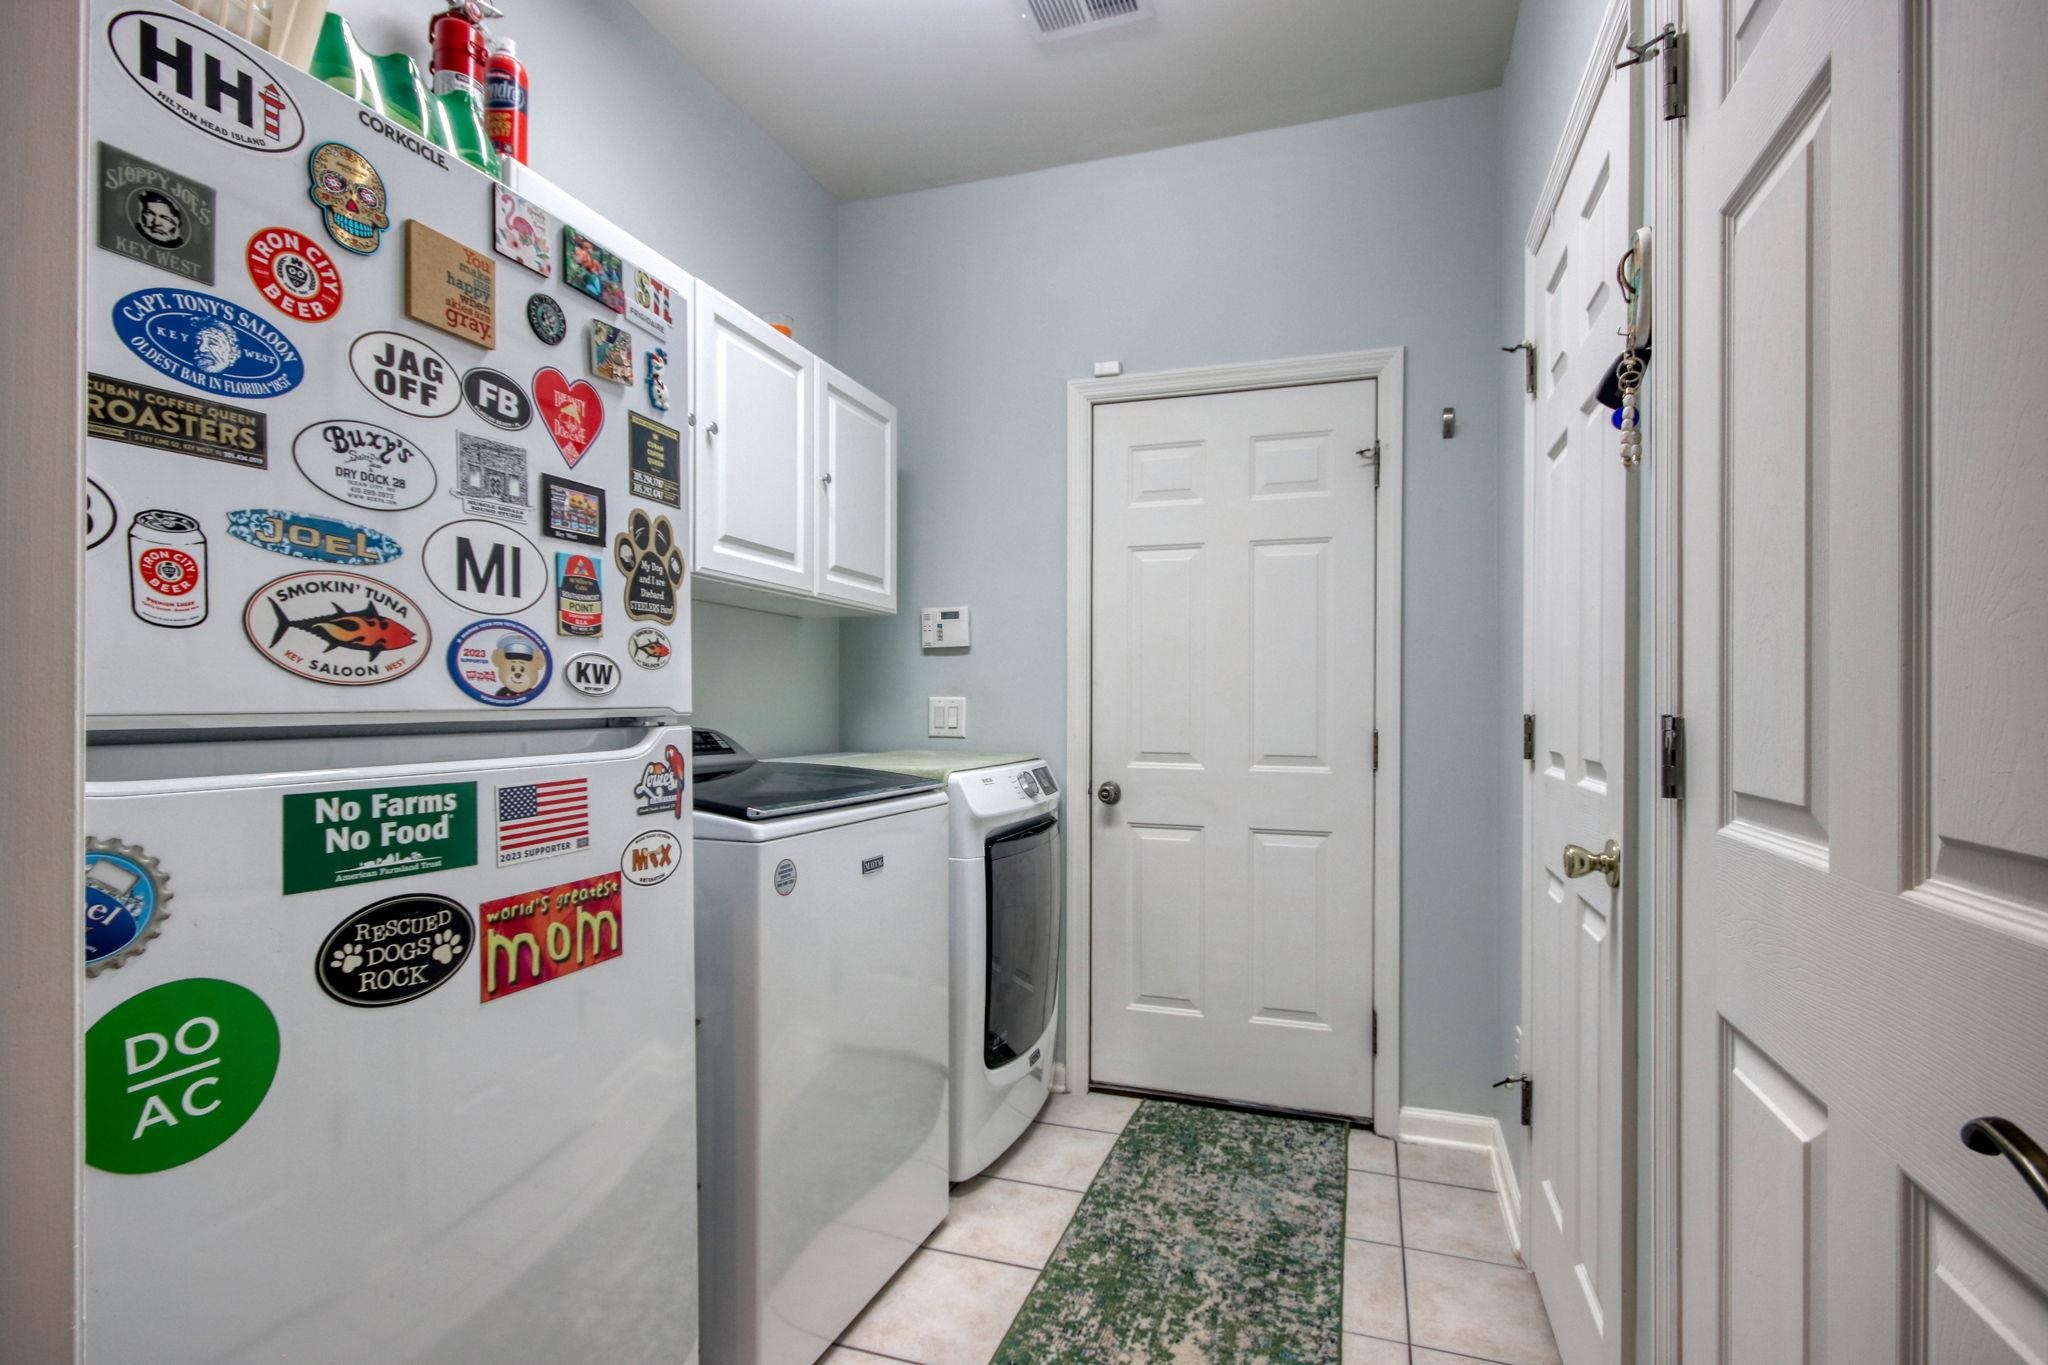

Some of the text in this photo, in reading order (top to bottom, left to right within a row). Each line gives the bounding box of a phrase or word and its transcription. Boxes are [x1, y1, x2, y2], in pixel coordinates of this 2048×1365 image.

[157, 90, 266, 146] HILTON HEAD ISLAND
[105, 166, 212, 226] SLOPPY JOE'S
[116, 236, 201, 277] KEY WEST
[251, 232, 340, 296] IRON CITY
[459, 262, 490, 284] make
[463, 248, 490, 274] You
[262, 283, 328, 318] BEER
[446, 270, 490, 304] happy
[460, 294, 490, 314] when
[123, 293, 298, 364] CAPT. TONY'S SALOON
[446, 308, 491, 340] gray.
[156, 326, 276, 365] KEY WEST
[130, 336, 180, 374] OLDEST
[180, 367, 206, 386] BAR
[209, 376, 222, 390] IN
[224, 379, 267, 395] FLORIDA
[373, 342, 444, 385] JAG
[87, 379, 257, 426] CUBAN COFFEE QUEEN
[374, 368, 438, 407] OFF
[478, 378, 520, 418] FB
[87, 394, 257, 450] ROASTERS
[322, 425, 415, 464] Buxy's
[336, 466, 358, 480] DRY
[360, 471, 390, 486] DOCK
[392, 477, 406, 489] 28
[255, 517, 379, 560] JOEL
[142, 551, 196, 572] IRON CITY
[456, 536, 522, 598] MI
[640, 560, 664, 576] My Dog
[148, 578, 192, 593] BEER
[276, 580, 409, 619] SMOKIN' TUNA
[640, 588, 665, 600] Diehard
[568, 602, 594, 612] POINT
[284, 650, 406, 677] KEY SALOON WEST
[463, 648, 486, 658] 2023
[576, 662, 614, 685] KW
[315, 792, 457, 824] No Farms
[325, 814, 450, 854] No Food
[500, 841, 572, 863] 2023 SUPPORTER
[335, 859, 442, 882] American Farmland Trust
[554, 880, 620, 912] greatest
[354, 910, 452, 944] RESCUED
[366, 936, 432, 968] DOGS
[488, 906, 618, 994] mom
[357, 964, 429, 993] ROCK
[124, 1016, 220, 1076] DO
[132, 1076, 222, 1141] AC
